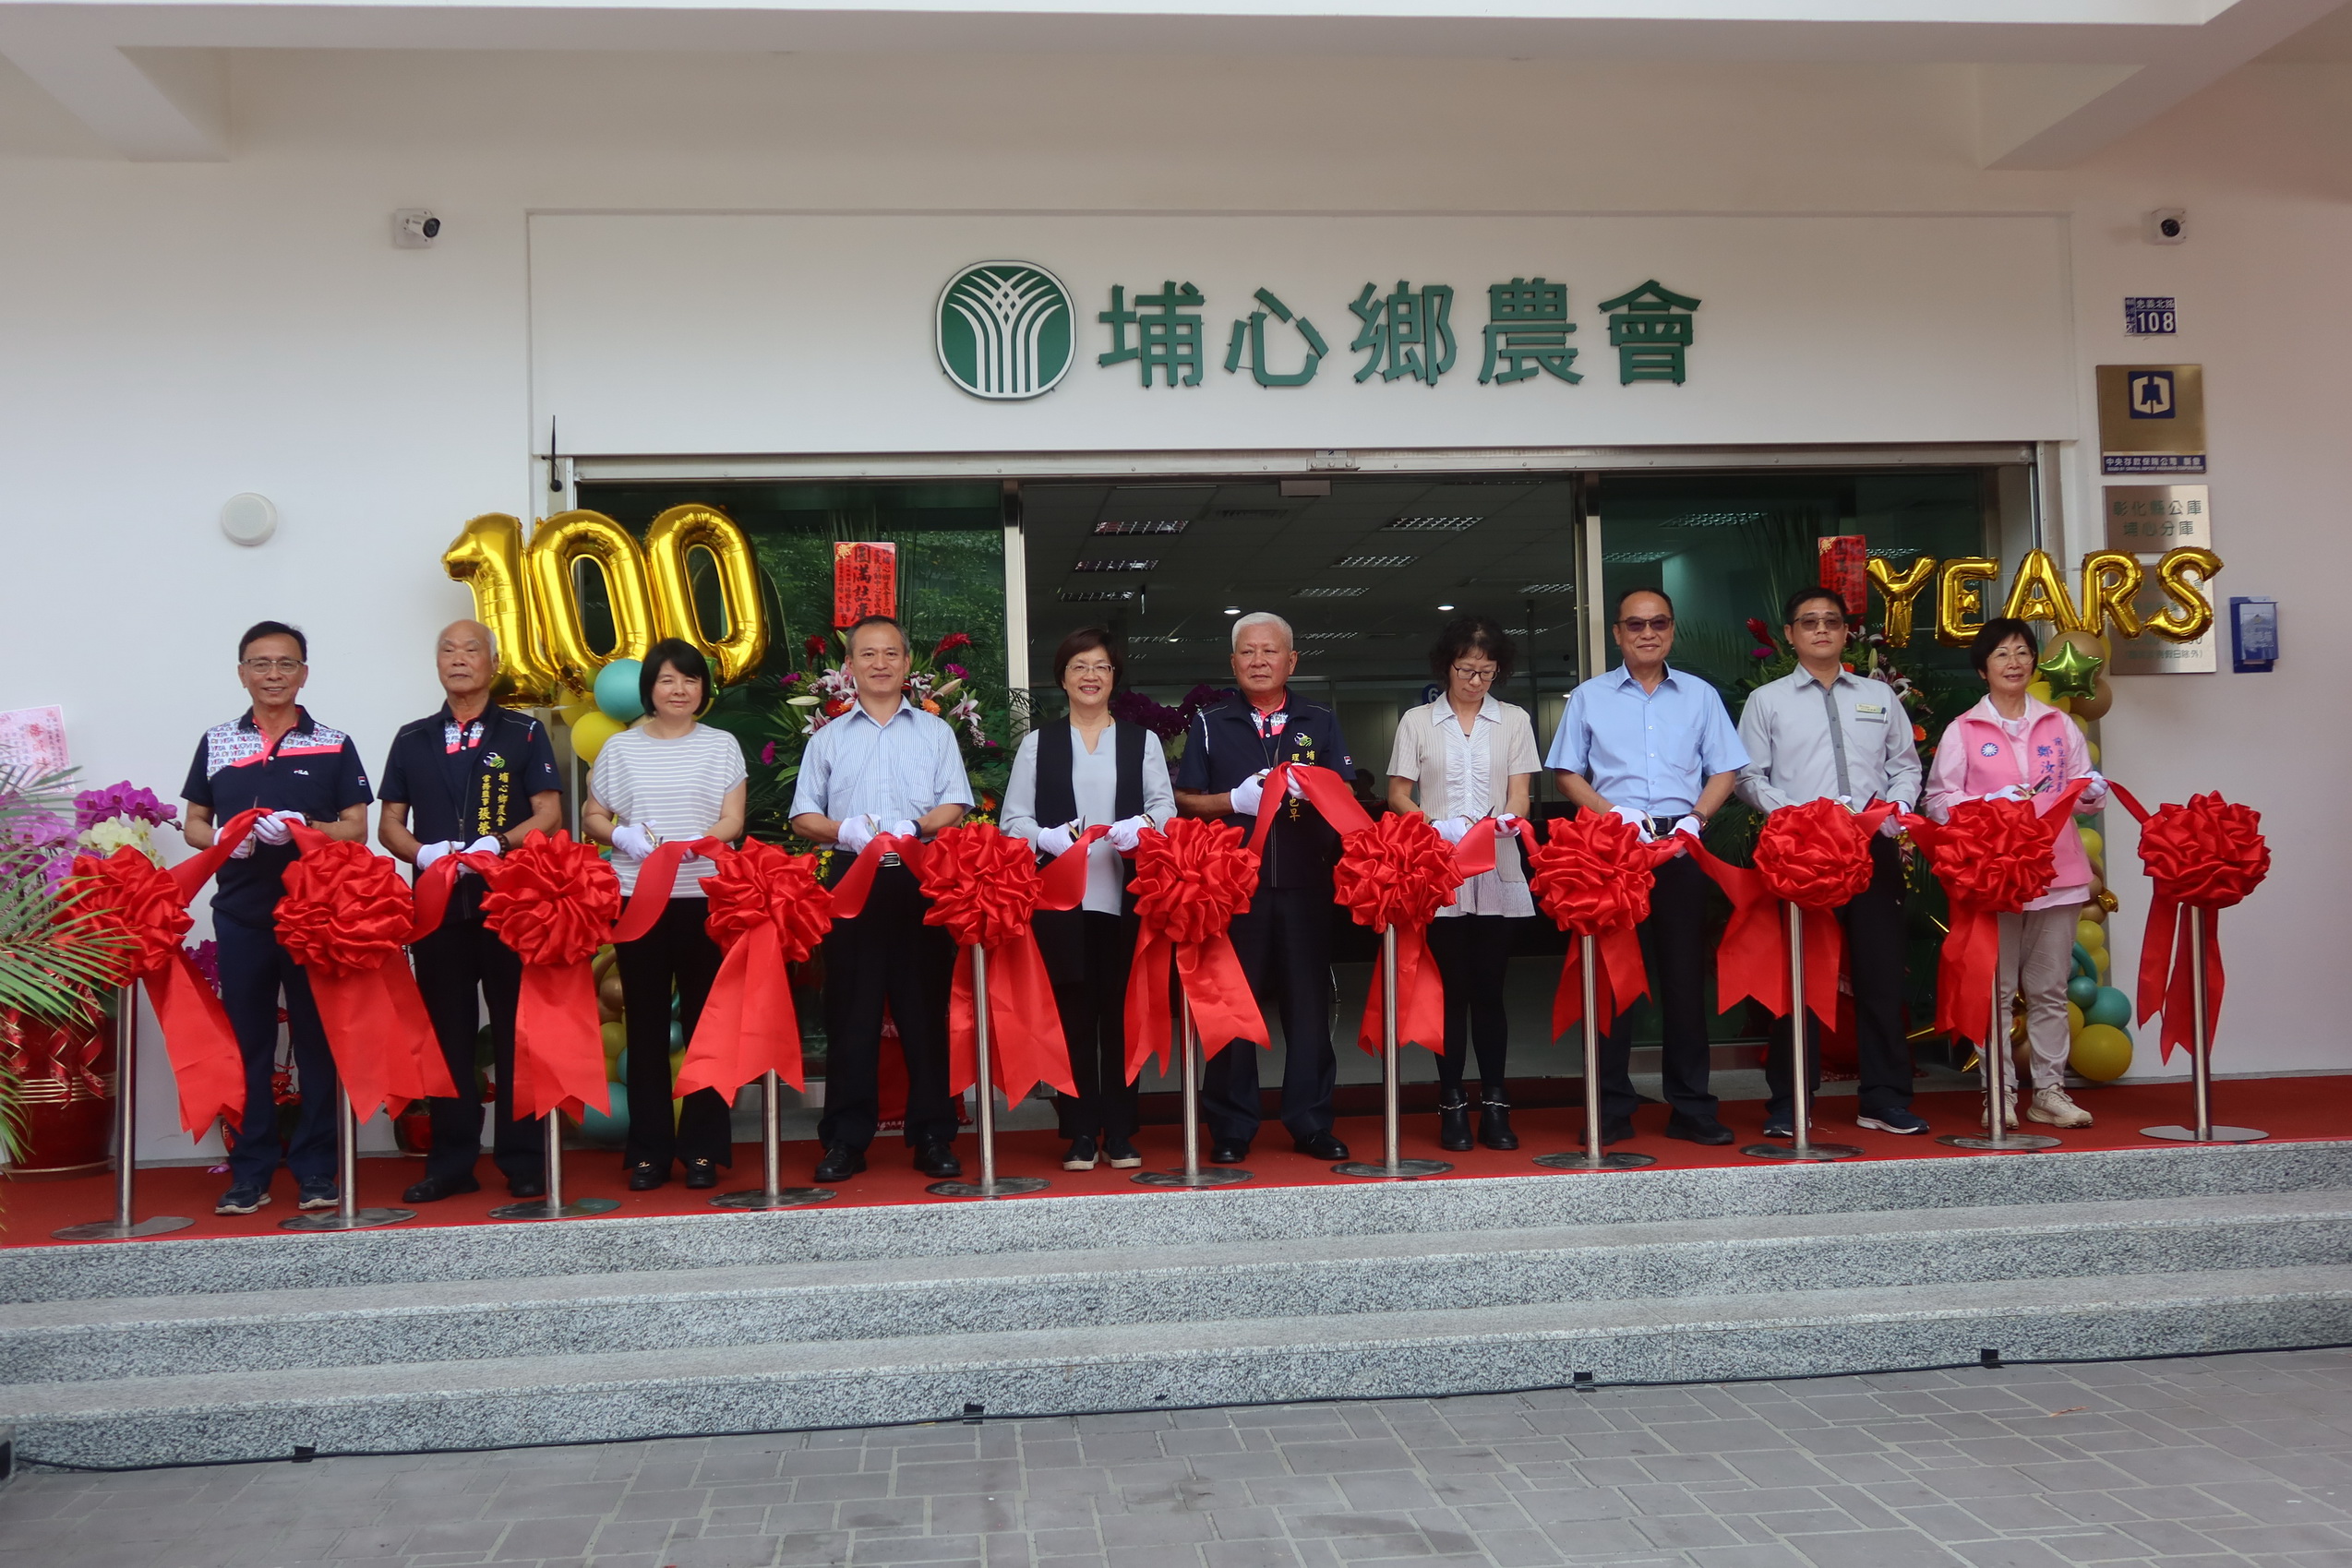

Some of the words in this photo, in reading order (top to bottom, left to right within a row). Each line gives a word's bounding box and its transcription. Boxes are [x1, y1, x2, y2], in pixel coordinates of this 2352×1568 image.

[1098, 279, 1701, 388] 埔心鄉農會
[2138, 312, 2174, 331] 108
[2113, 499, 2202, 516] 彰化縣公庫
[441, 504, 770, 710] 100
[1864, 545, 2225, 648] YEARS
[1428, 688, 1438, 702] 6
[496, 772, 510, 827] 埔心鄉農會
